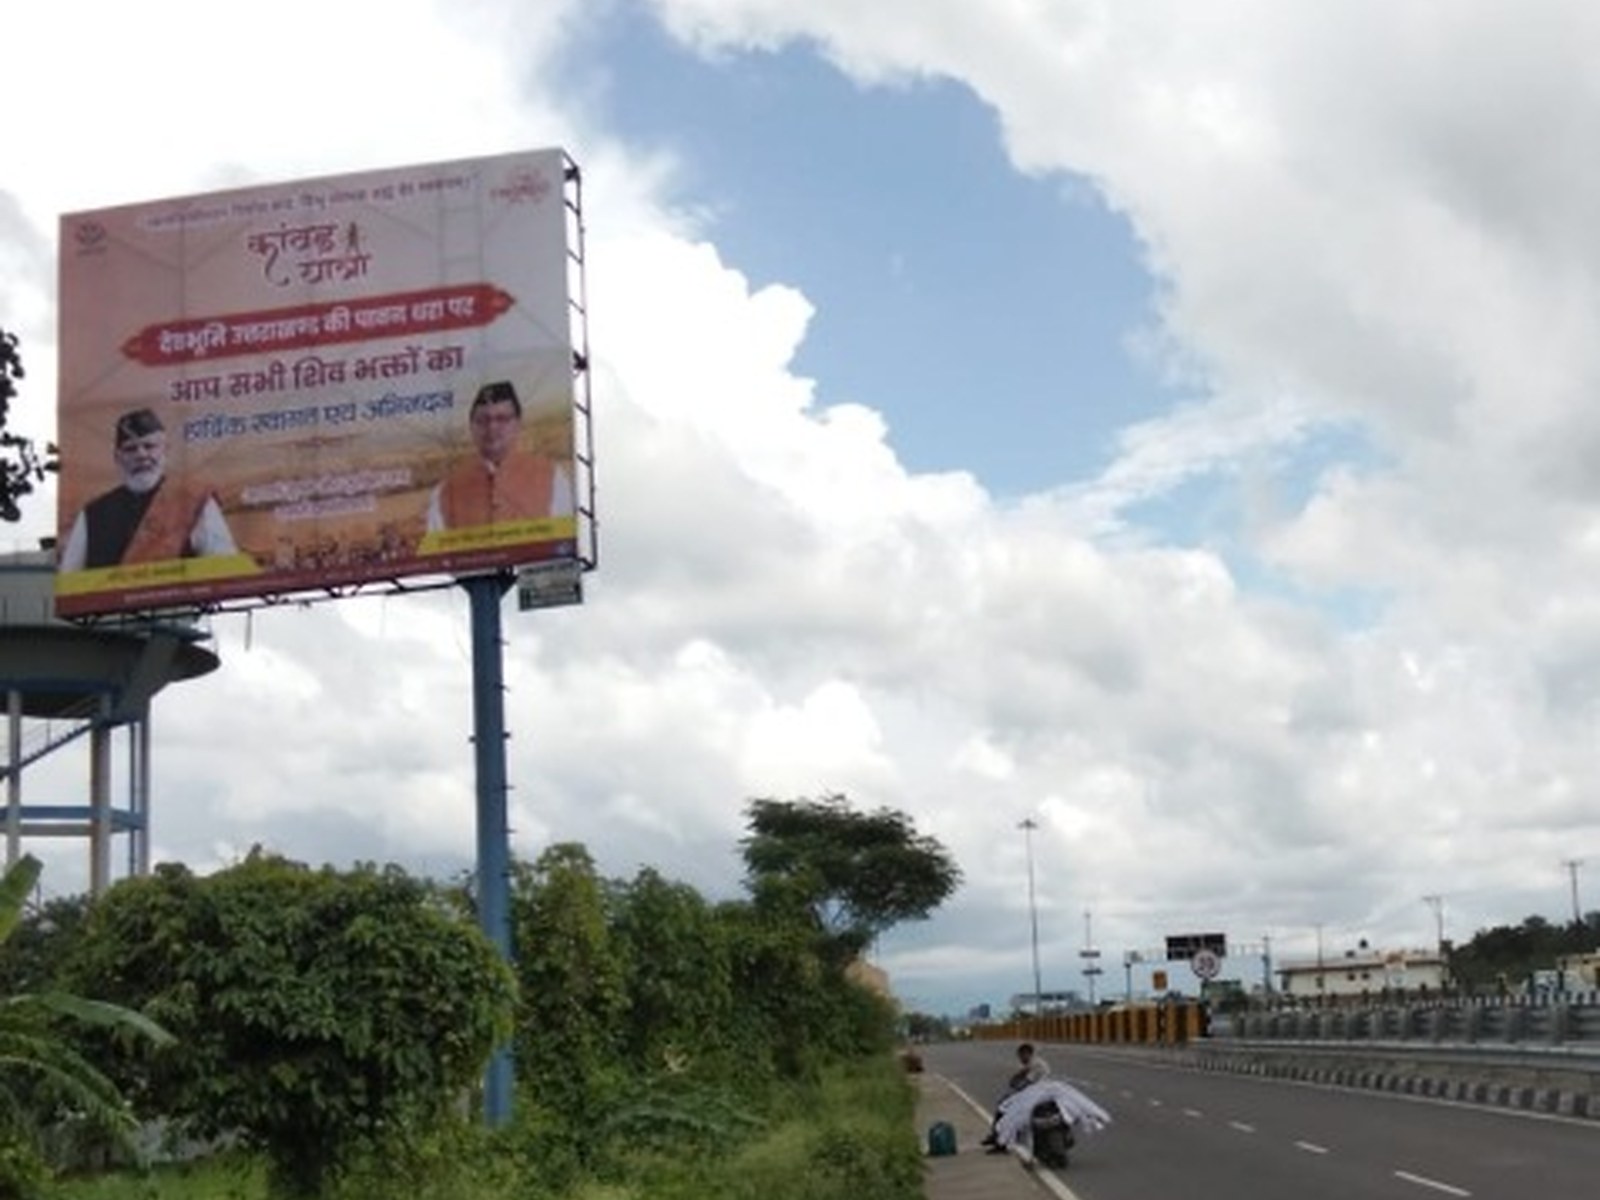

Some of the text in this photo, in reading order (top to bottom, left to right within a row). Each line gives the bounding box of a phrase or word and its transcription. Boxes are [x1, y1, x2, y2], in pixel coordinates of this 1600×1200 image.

[323, 306, 351, 332] की
[448, 296, 475, 317] पर
[171, 346, 464, 401] आप सभी शिव भक्तों का
[249, 406, 319, 434] स्वागत
